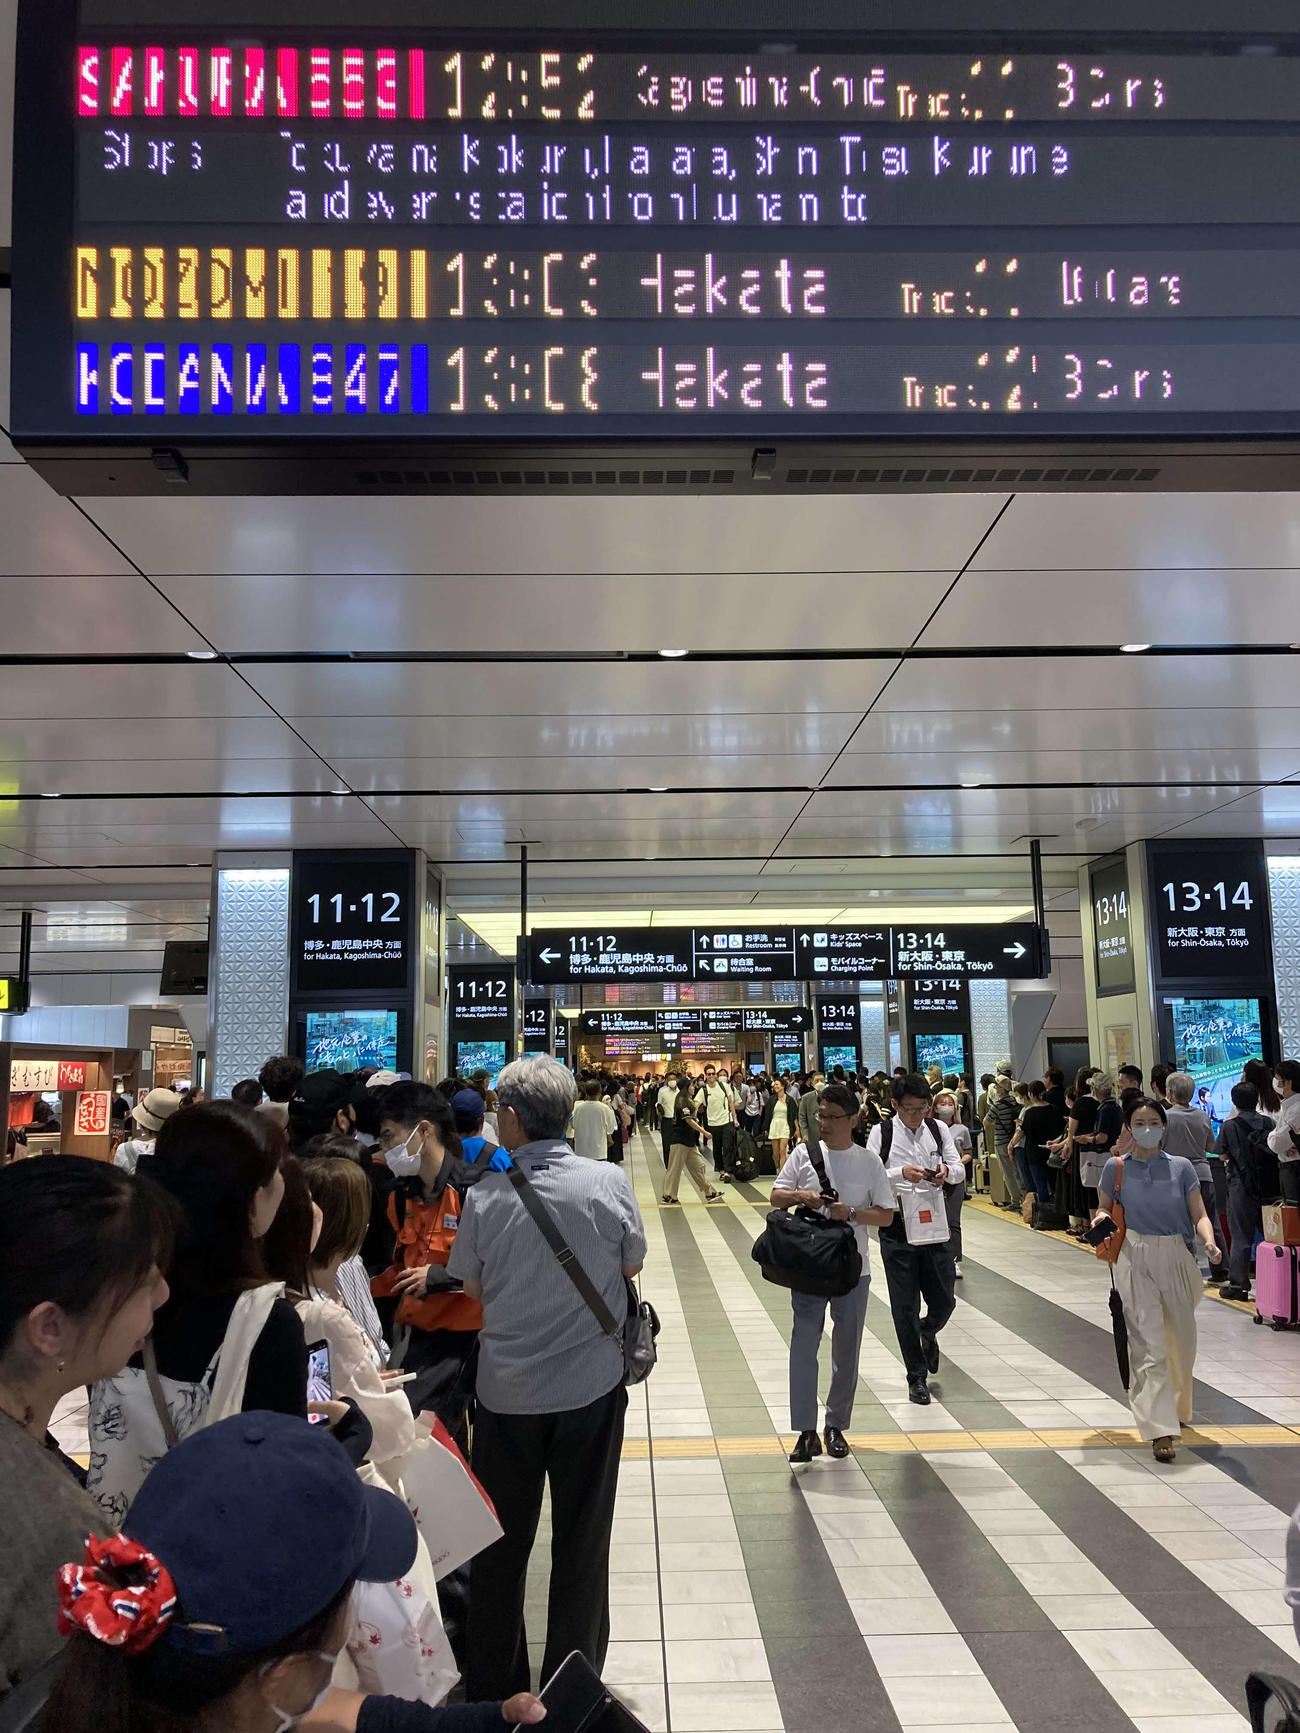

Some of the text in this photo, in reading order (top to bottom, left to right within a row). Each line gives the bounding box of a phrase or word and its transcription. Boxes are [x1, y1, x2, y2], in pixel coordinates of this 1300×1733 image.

[1162, 881, 1254, 912] 13·14
[308, 892, 401, 924] 11·12
[830, 932, 884, 940] キッズスペース
[1167, 926, 1246, 938] 新大阪・東京 方面
[745, 934, 768, 942] お手洗
[897, 932, 946, 949] 13·14
[1168, 939, 1180, 947] for
[304, 939, 384, 951] 博多・鹿児島中央
[569, 936, 617, 952] 11·12
[304, 952, 314, 960] for
[316, 952, 342, 960] Hakata,
[569, 953, 654, 964] 博多・鹿児島中央
[830, 956, 886, 965] モバイルコーナー
[898, 950, 966, 962] 新大阪・東京
[730, 958, 754, 966] 待合室
[898, 962, 911, 971] for
[569, 964, 582, 974] for
[584, 964, 616, 974] Hakata,
[456, 980, 507, 998] 11·12
[822, 1006, 856, 1017] 13·14
